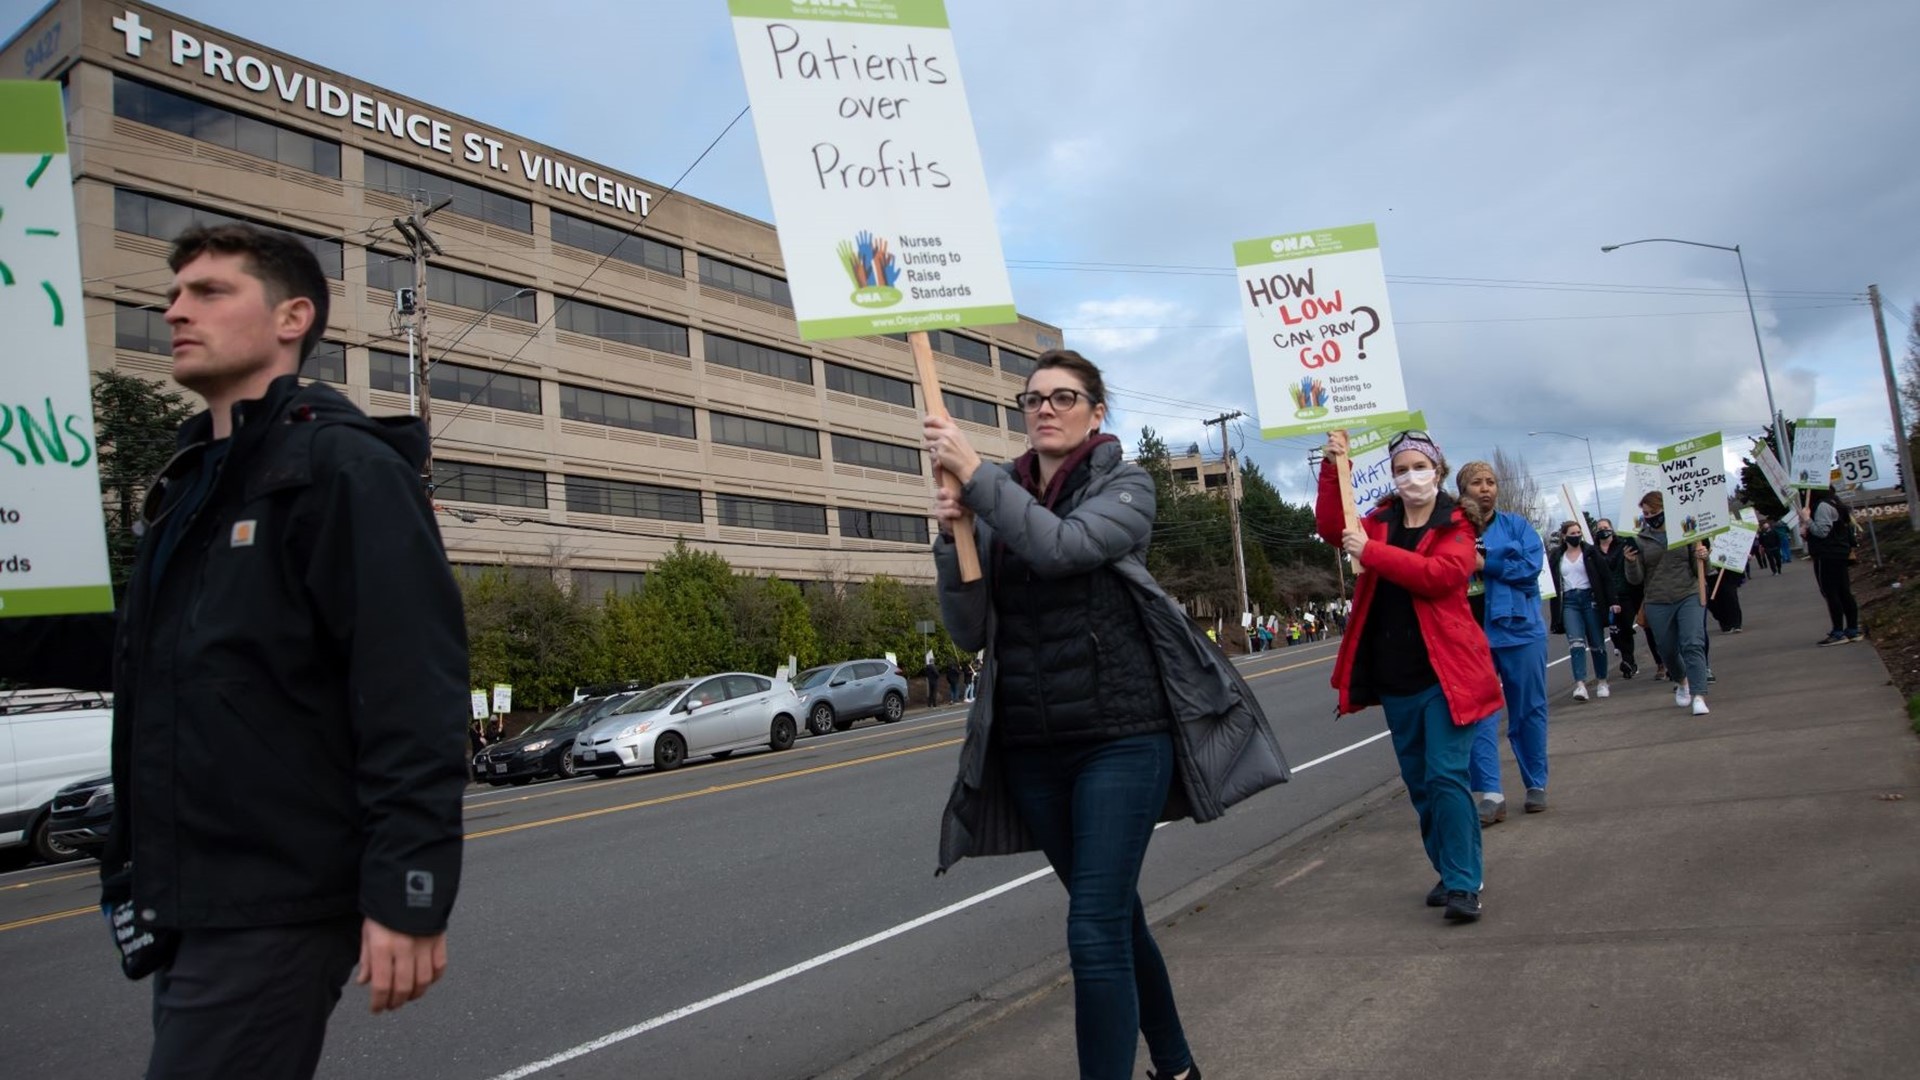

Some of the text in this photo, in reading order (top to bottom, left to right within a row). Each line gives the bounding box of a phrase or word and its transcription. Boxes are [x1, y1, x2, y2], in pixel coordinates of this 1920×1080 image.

[766, 23, 948, 85] Patients
[838, 96, 910, 120] over
[171, 29, 652, 217] PROVIDENCE ST. VINCENT
[811, 139, 951, 190] Profits
[899, 235, 942, 248] Nurses
[1270, 235, 1316, 253] ONA
[903, 251, 961, 266] Uniting to
[907, 269, 941, 282] Raise
[911, 284, 971, 300] Standards
[1246, 267, 1315, 307] HOW
[1279, 289, 1342, 325] LOW
[1273, 319, 1356, 349] CAN PROV
[1299, 339, 1341, 369] GO
[1329, 374, 1359, 384] Nurses
[1330, 382, 1372, 394] Uniting to
[1332, 394, 1356, 403] Raise
[1334, 401, 1377, 413] Standards
[1840, 448, 1869, 460] SPEED
[1661, 456, 1697, 473] WHAT
[1844, 459, 1873, 481] 35
[1669, 467, 1710, 483] WOULD
[1353, 482, 1397, 505] WOUL
[1667, 474, 1726, 496] THE SISTERS
[1679, 489, 1705, 505] SAY?
